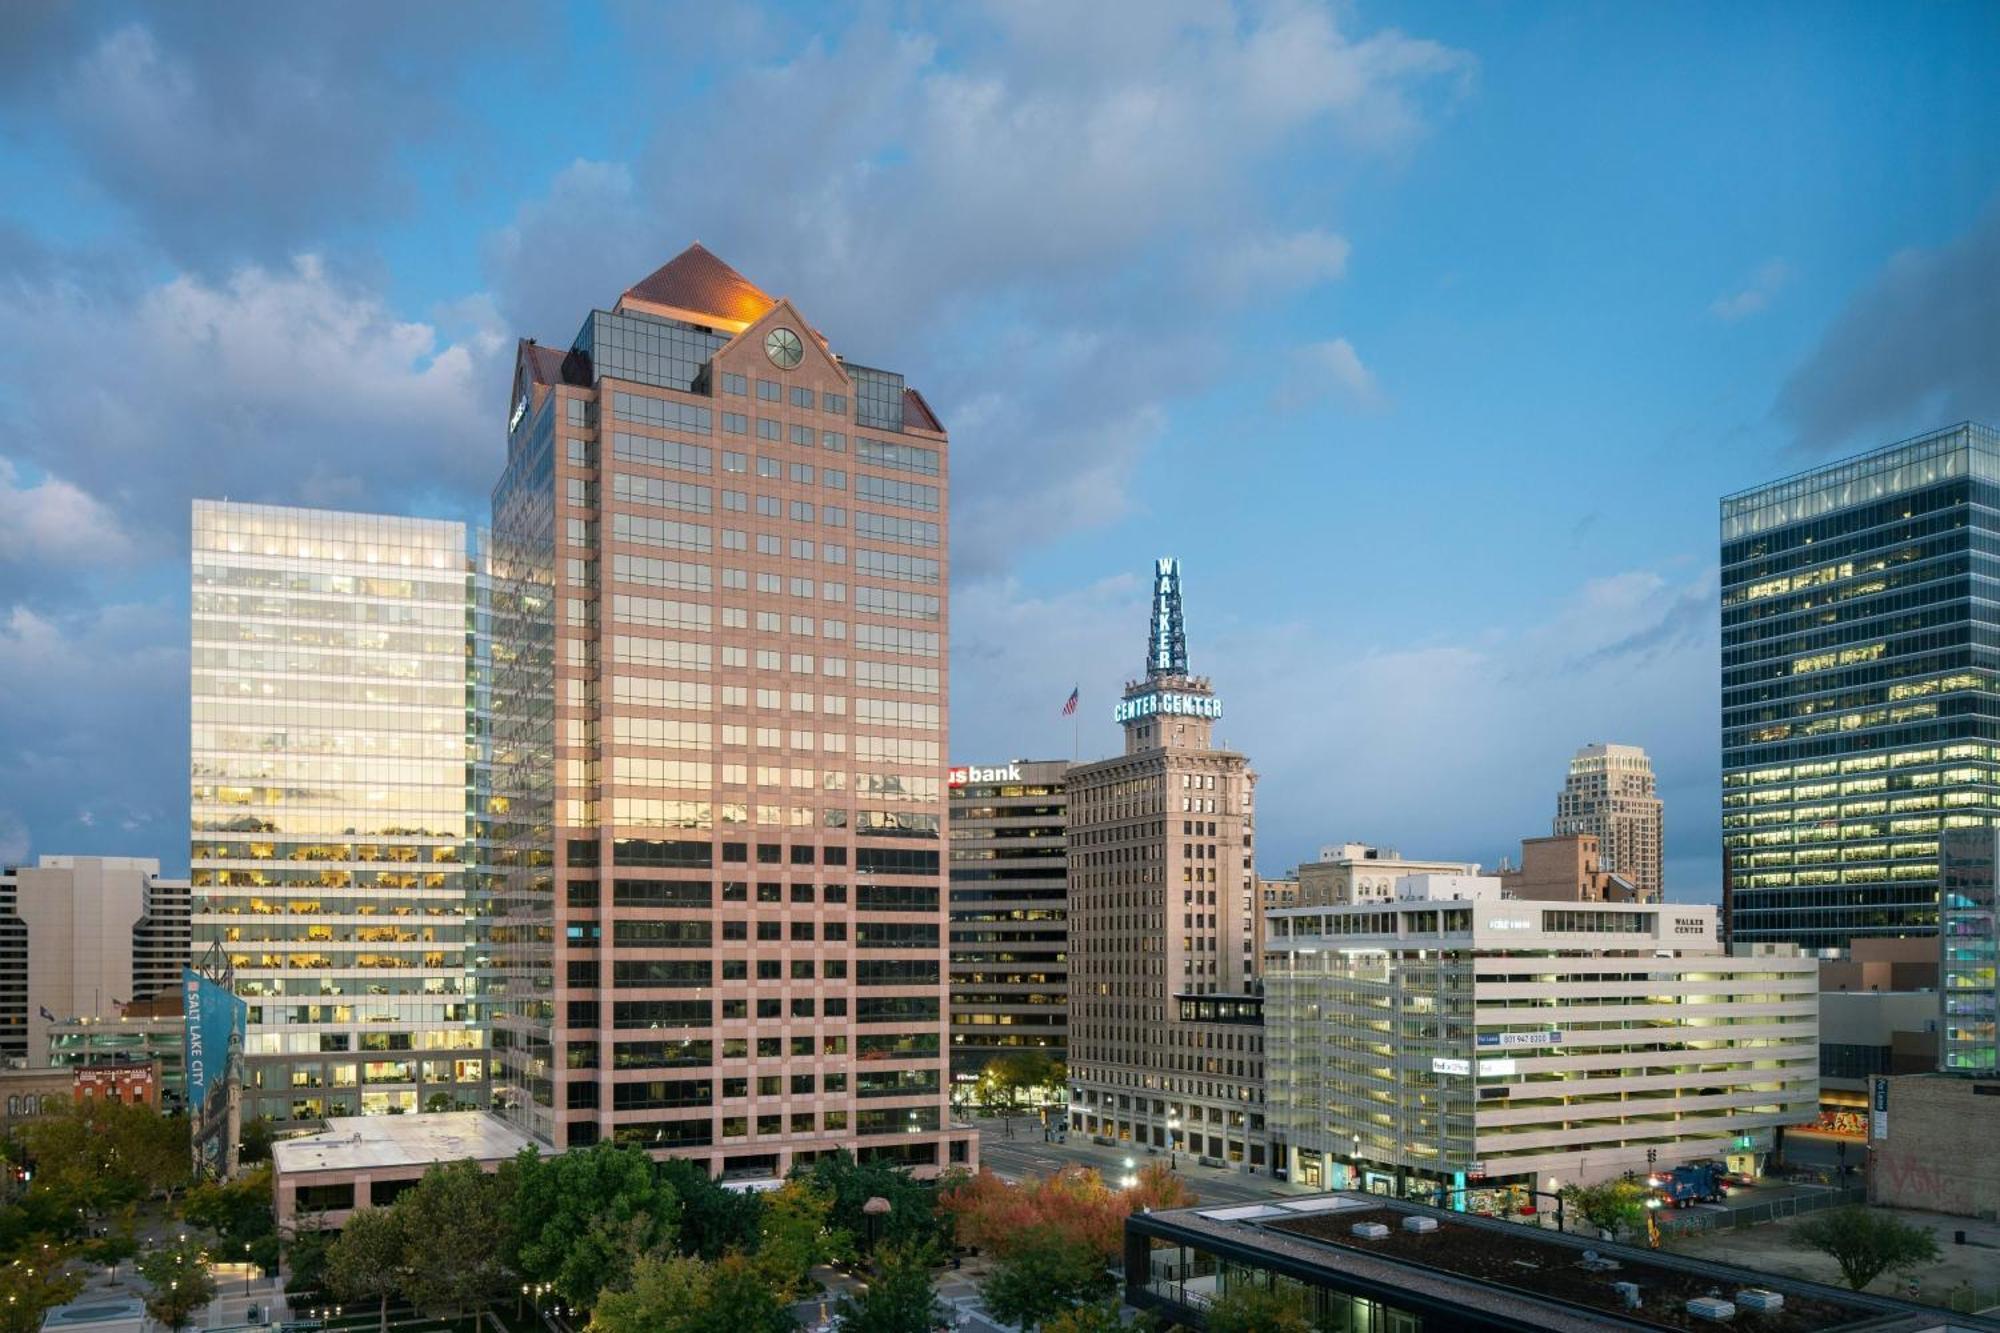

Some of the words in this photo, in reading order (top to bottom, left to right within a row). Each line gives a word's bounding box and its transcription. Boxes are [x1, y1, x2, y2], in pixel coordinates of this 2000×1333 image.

[1159, 558, 1173, 668] WALKER
[1115, 694, 1157, 721] CENTER
[1163, 694, 1222, 717] CENTER
[188, 993, 200, 1020] SALT
[190, 1026, 202, 1056] LAKE
[191, 1060, 204, 1086] CITY
